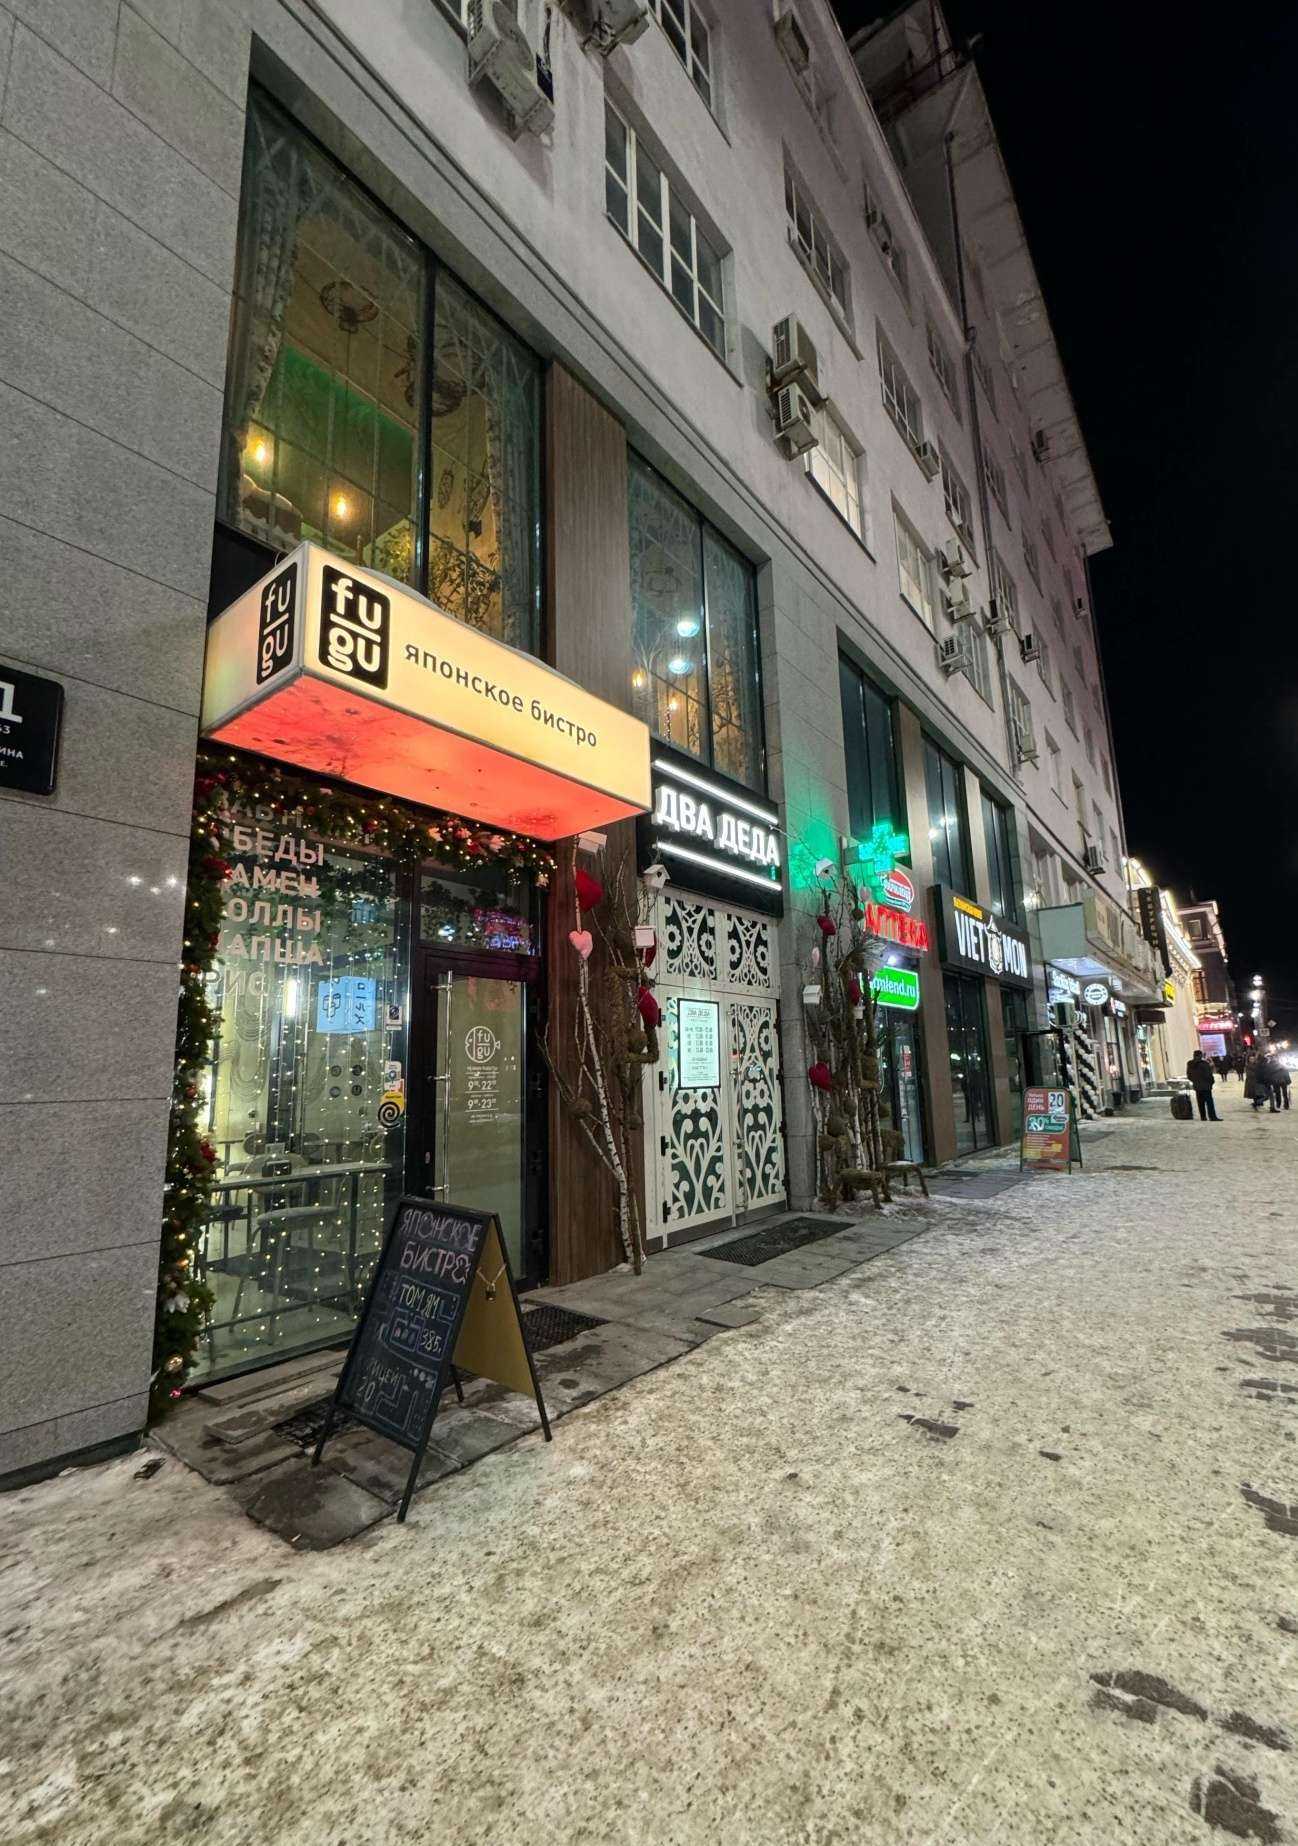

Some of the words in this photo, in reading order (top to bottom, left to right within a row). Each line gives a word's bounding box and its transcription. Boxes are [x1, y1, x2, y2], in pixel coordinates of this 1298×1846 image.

[265, 580, 291, 623] fu
[331, 578, 382, 630] fu
[261, 624, 289, 677] gu
[328, 627, 381, 672] gu
[405, 643, 524, 713] японское
[530, 699, 598, 748] бистро
[224, 825, 325, 867] БЕДЫ
[651, 785, 714, 840] ДВА
[714, 813, 781, 868] ДЕДА
[229, 862, 322, 899] АМЕН
[227, 897, 322, 933] ОЛЛЫ
[954, 910, 986, 963] VIET
[1002, 933, 1028, 979] MON
[476, 1046, 491, 1060] gu
[477, 1029, 491, 1043] fu
[1049, 1093, 1065, 1108] 20
[401, 1208, 483, 1252] ЯПОНСКОЕ
[401, 1241, 472, 1286] БИСТРО
[400, 1283, 426, 1312] ТОМ
